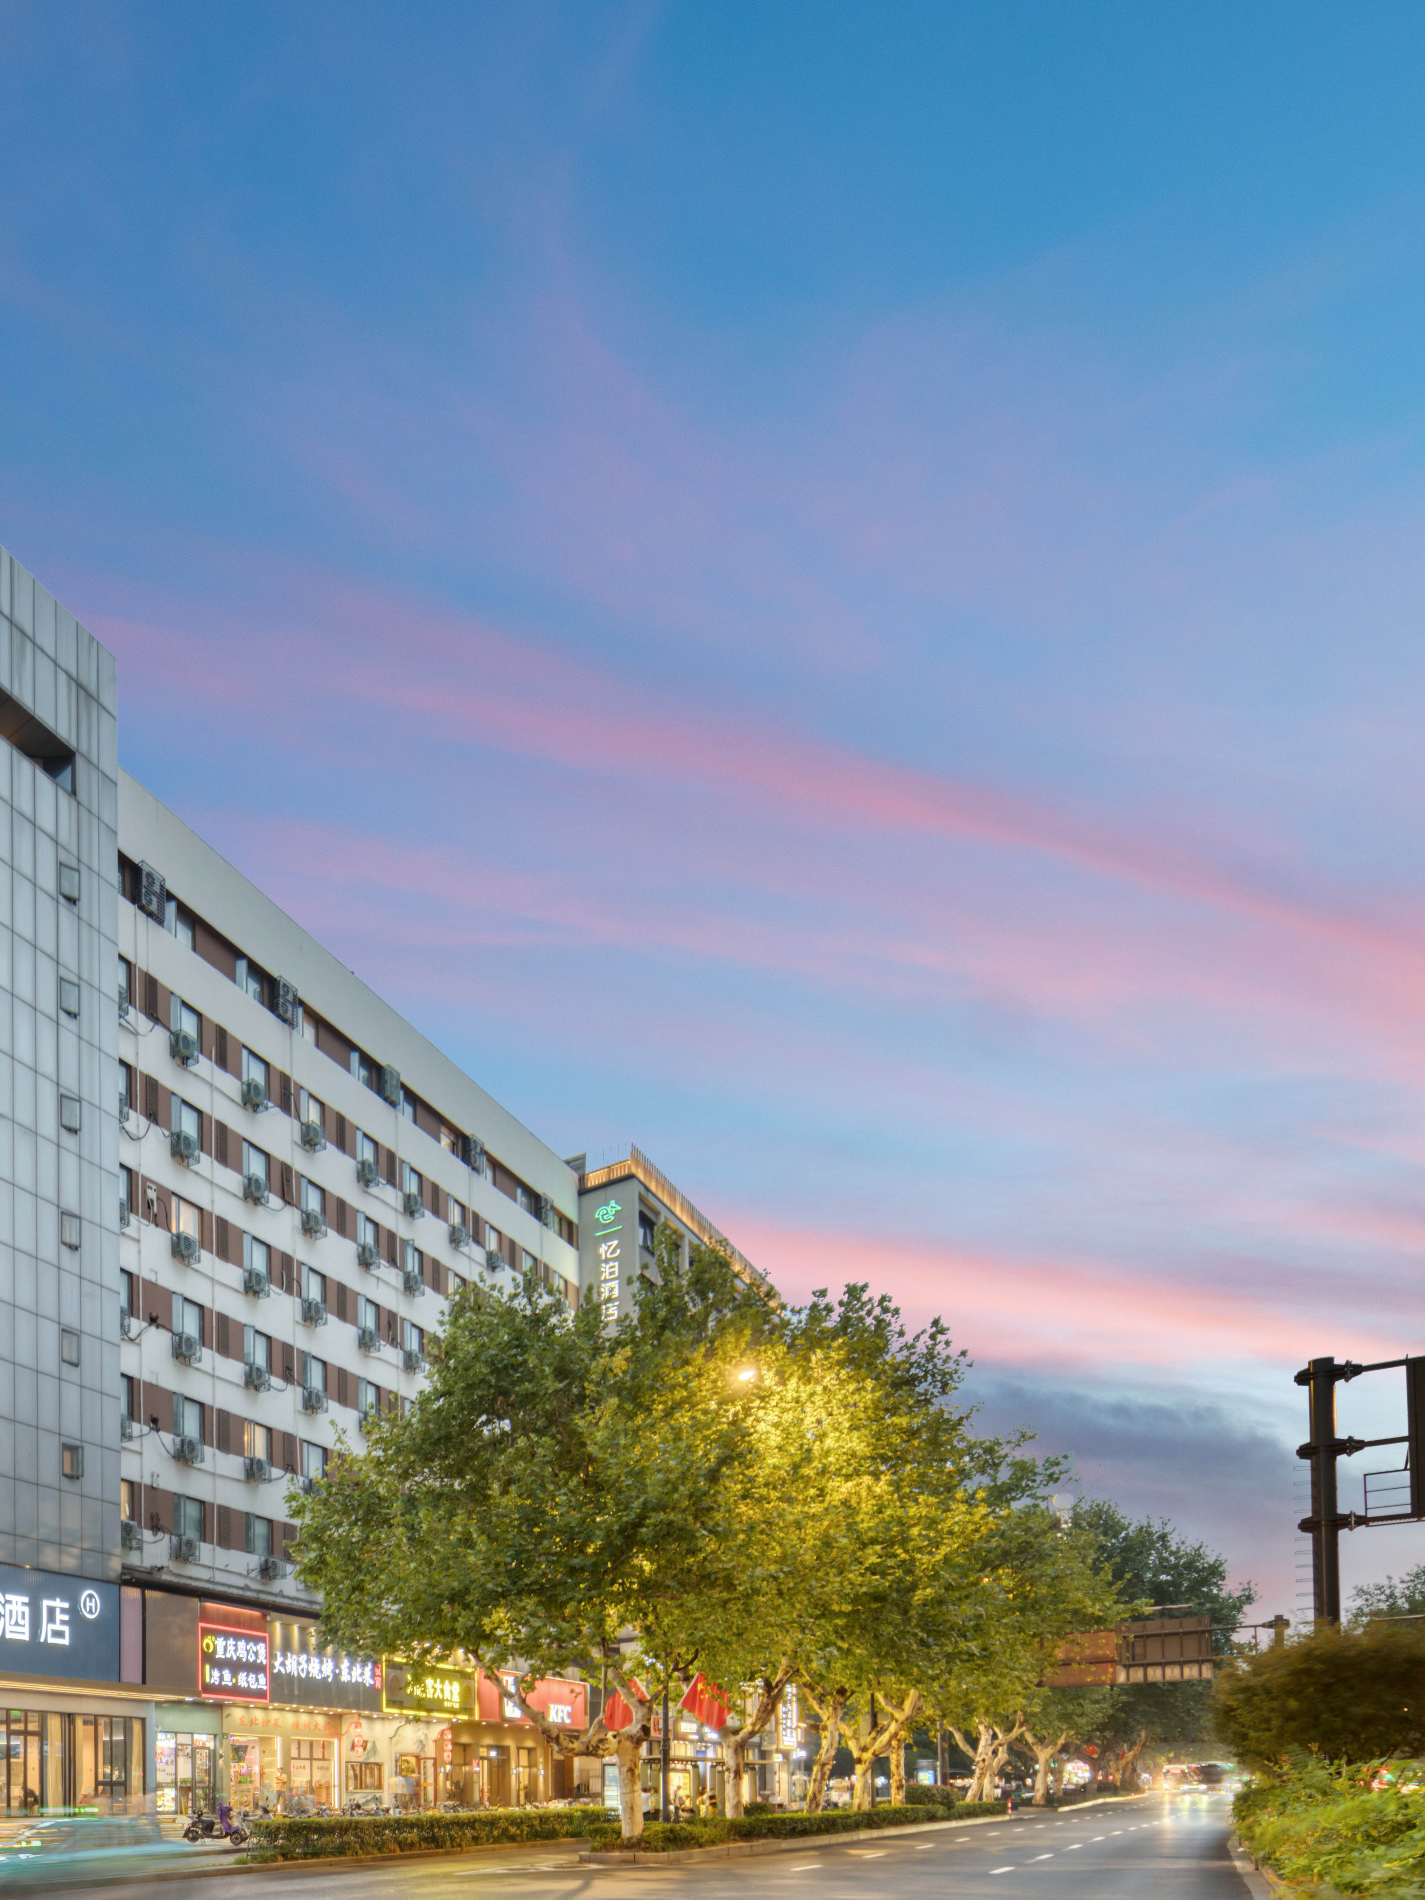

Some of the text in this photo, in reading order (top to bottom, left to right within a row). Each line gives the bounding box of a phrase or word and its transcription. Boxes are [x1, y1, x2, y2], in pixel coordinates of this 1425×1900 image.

[599, 1239, 621, 1321] 忆泊酒店
[214, 1636, 267, 1665] 重庆鸡公煲
[548, 1703, 572, 1723] KFC
